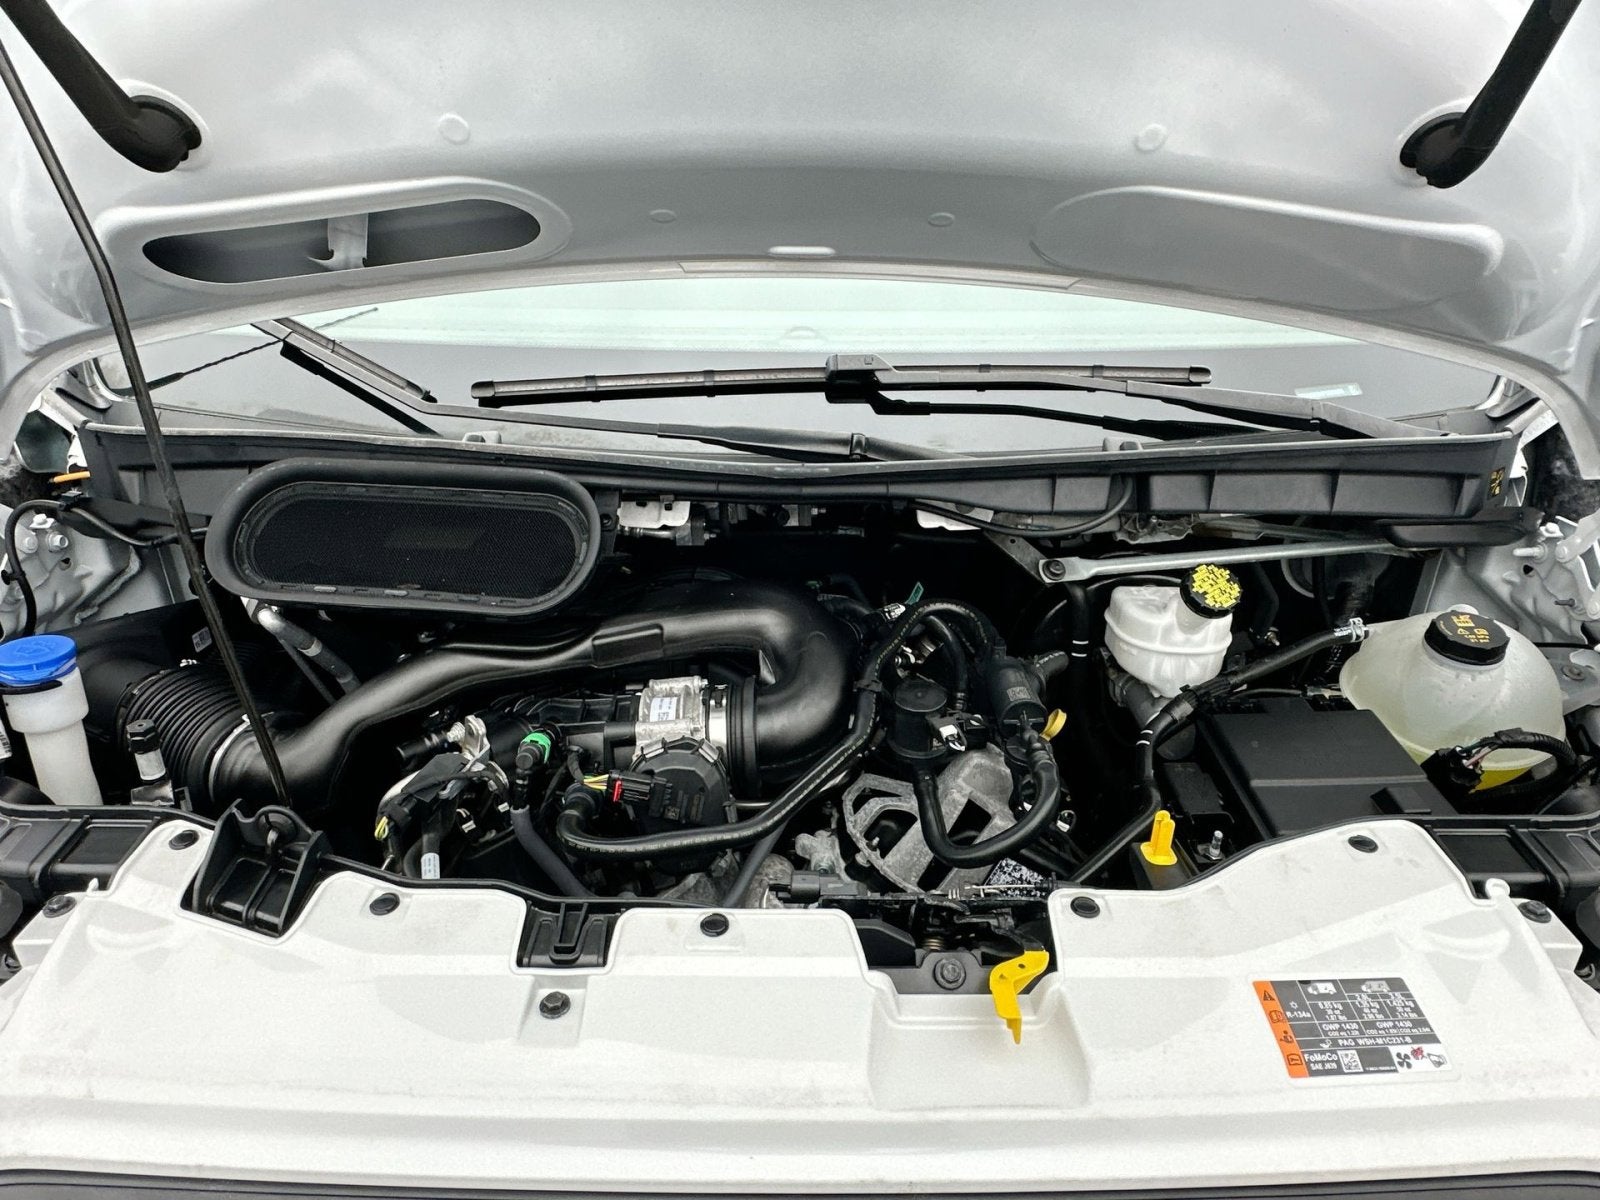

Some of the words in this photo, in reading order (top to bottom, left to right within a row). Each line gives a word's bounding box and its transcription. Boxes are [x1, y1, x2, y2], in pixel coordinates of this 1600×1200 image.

[1286, 1010, 1312, 1018] R-134a
[1338, 1038, 1354, 1047] PAG
[1304, 1052, 1338, 1062] FoMoCo
[1310, 1062, 1323, 1070] SAE
